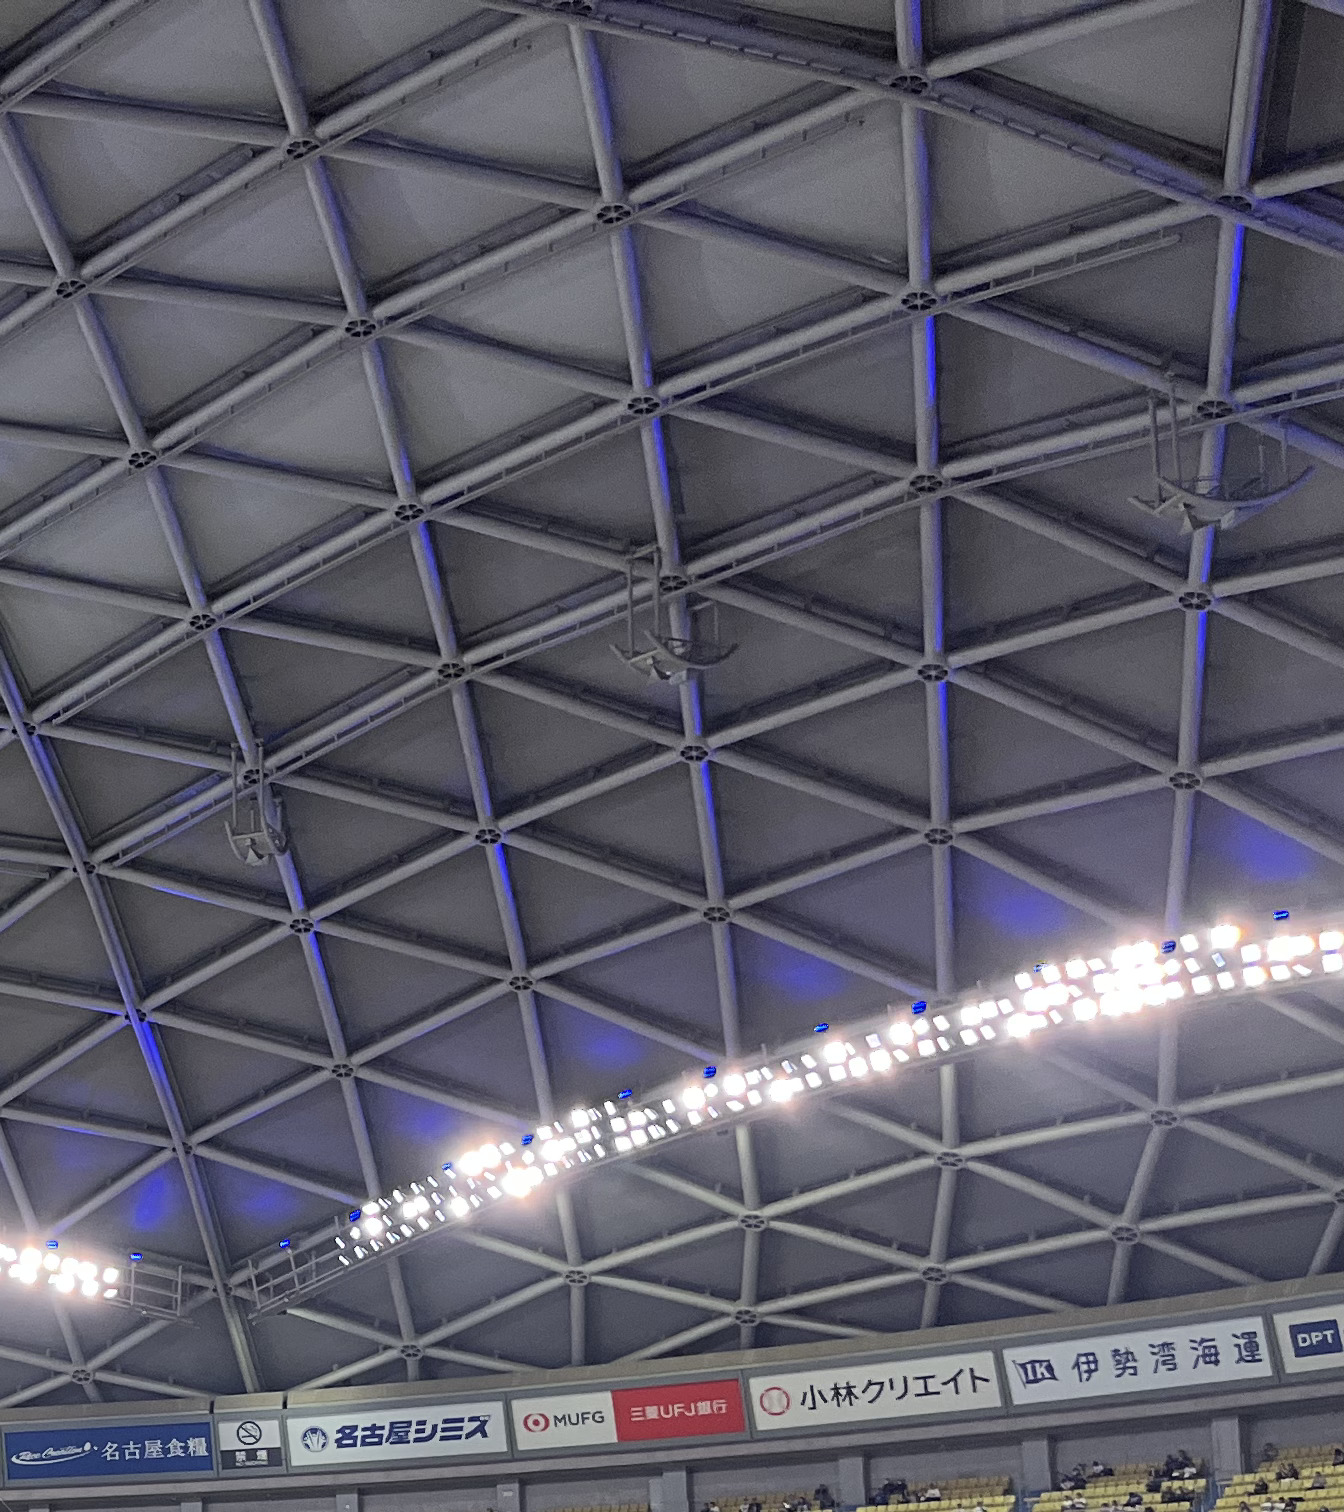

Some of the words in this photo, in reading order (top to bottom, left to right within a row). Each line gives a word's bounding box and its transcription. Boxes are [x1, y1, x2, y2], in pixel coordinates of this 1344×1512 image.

[1296, 1329, 1335, 1347] DPT
[1072, 1331, 1263, 1383] 伊勢湾海運
[800, 1367, 991, 1411] 小林クリエイト
[334, 1414, 491, 1449] 名古屋シミズ
[553, 1411, 605, 1427] MUFG
[101, 1436, 209, 1461] 名古屋食糧
